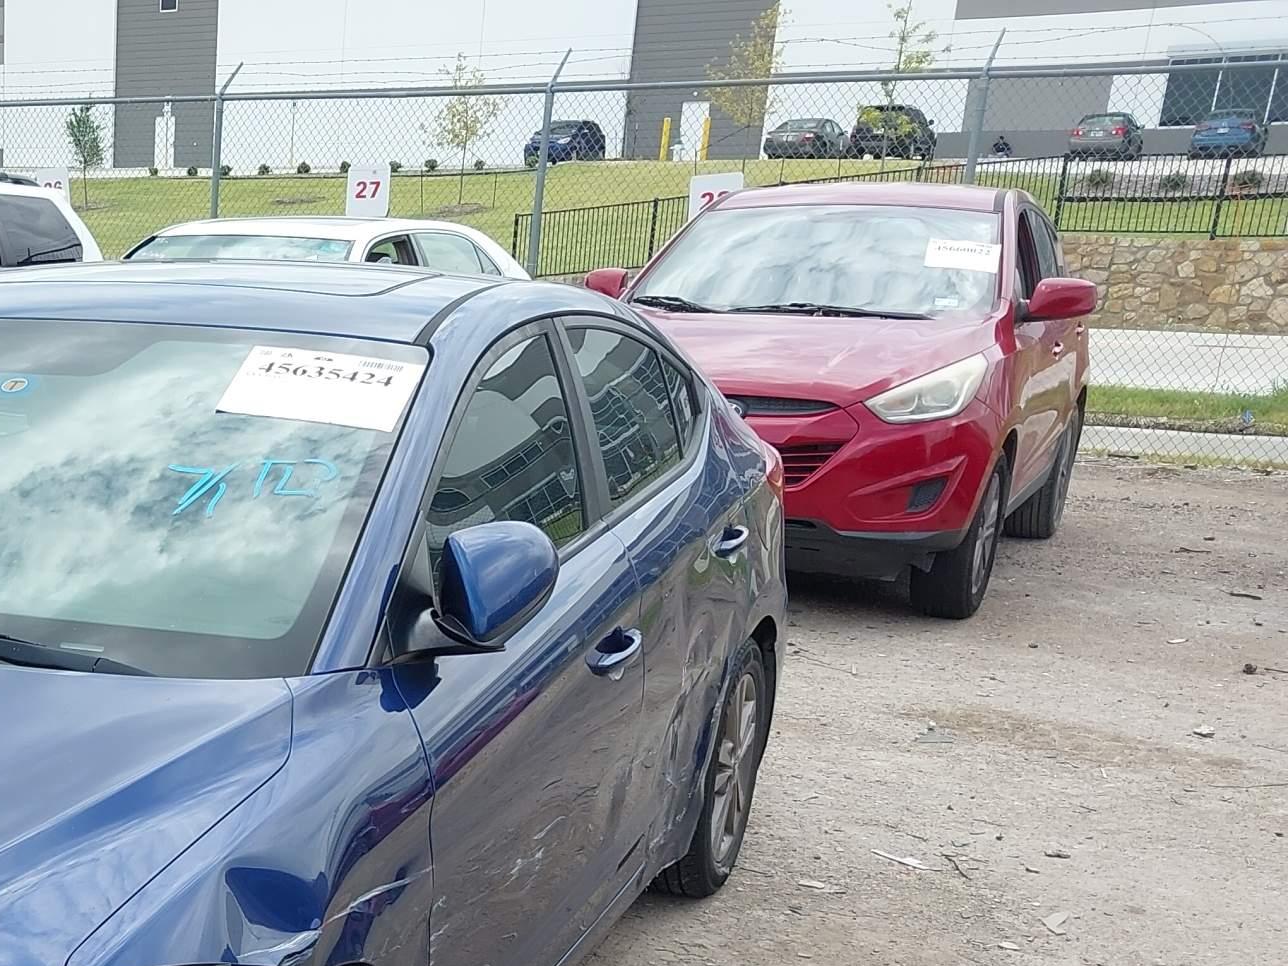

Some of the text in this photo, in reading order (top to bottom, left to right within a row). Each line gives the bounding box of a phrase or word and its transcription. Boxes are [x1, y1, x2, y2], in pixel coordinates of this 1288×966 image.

[355, 181, 381, 199] 27
[699, 190, 729, 211] 2
[258, 361, 394, 387] 45635424
